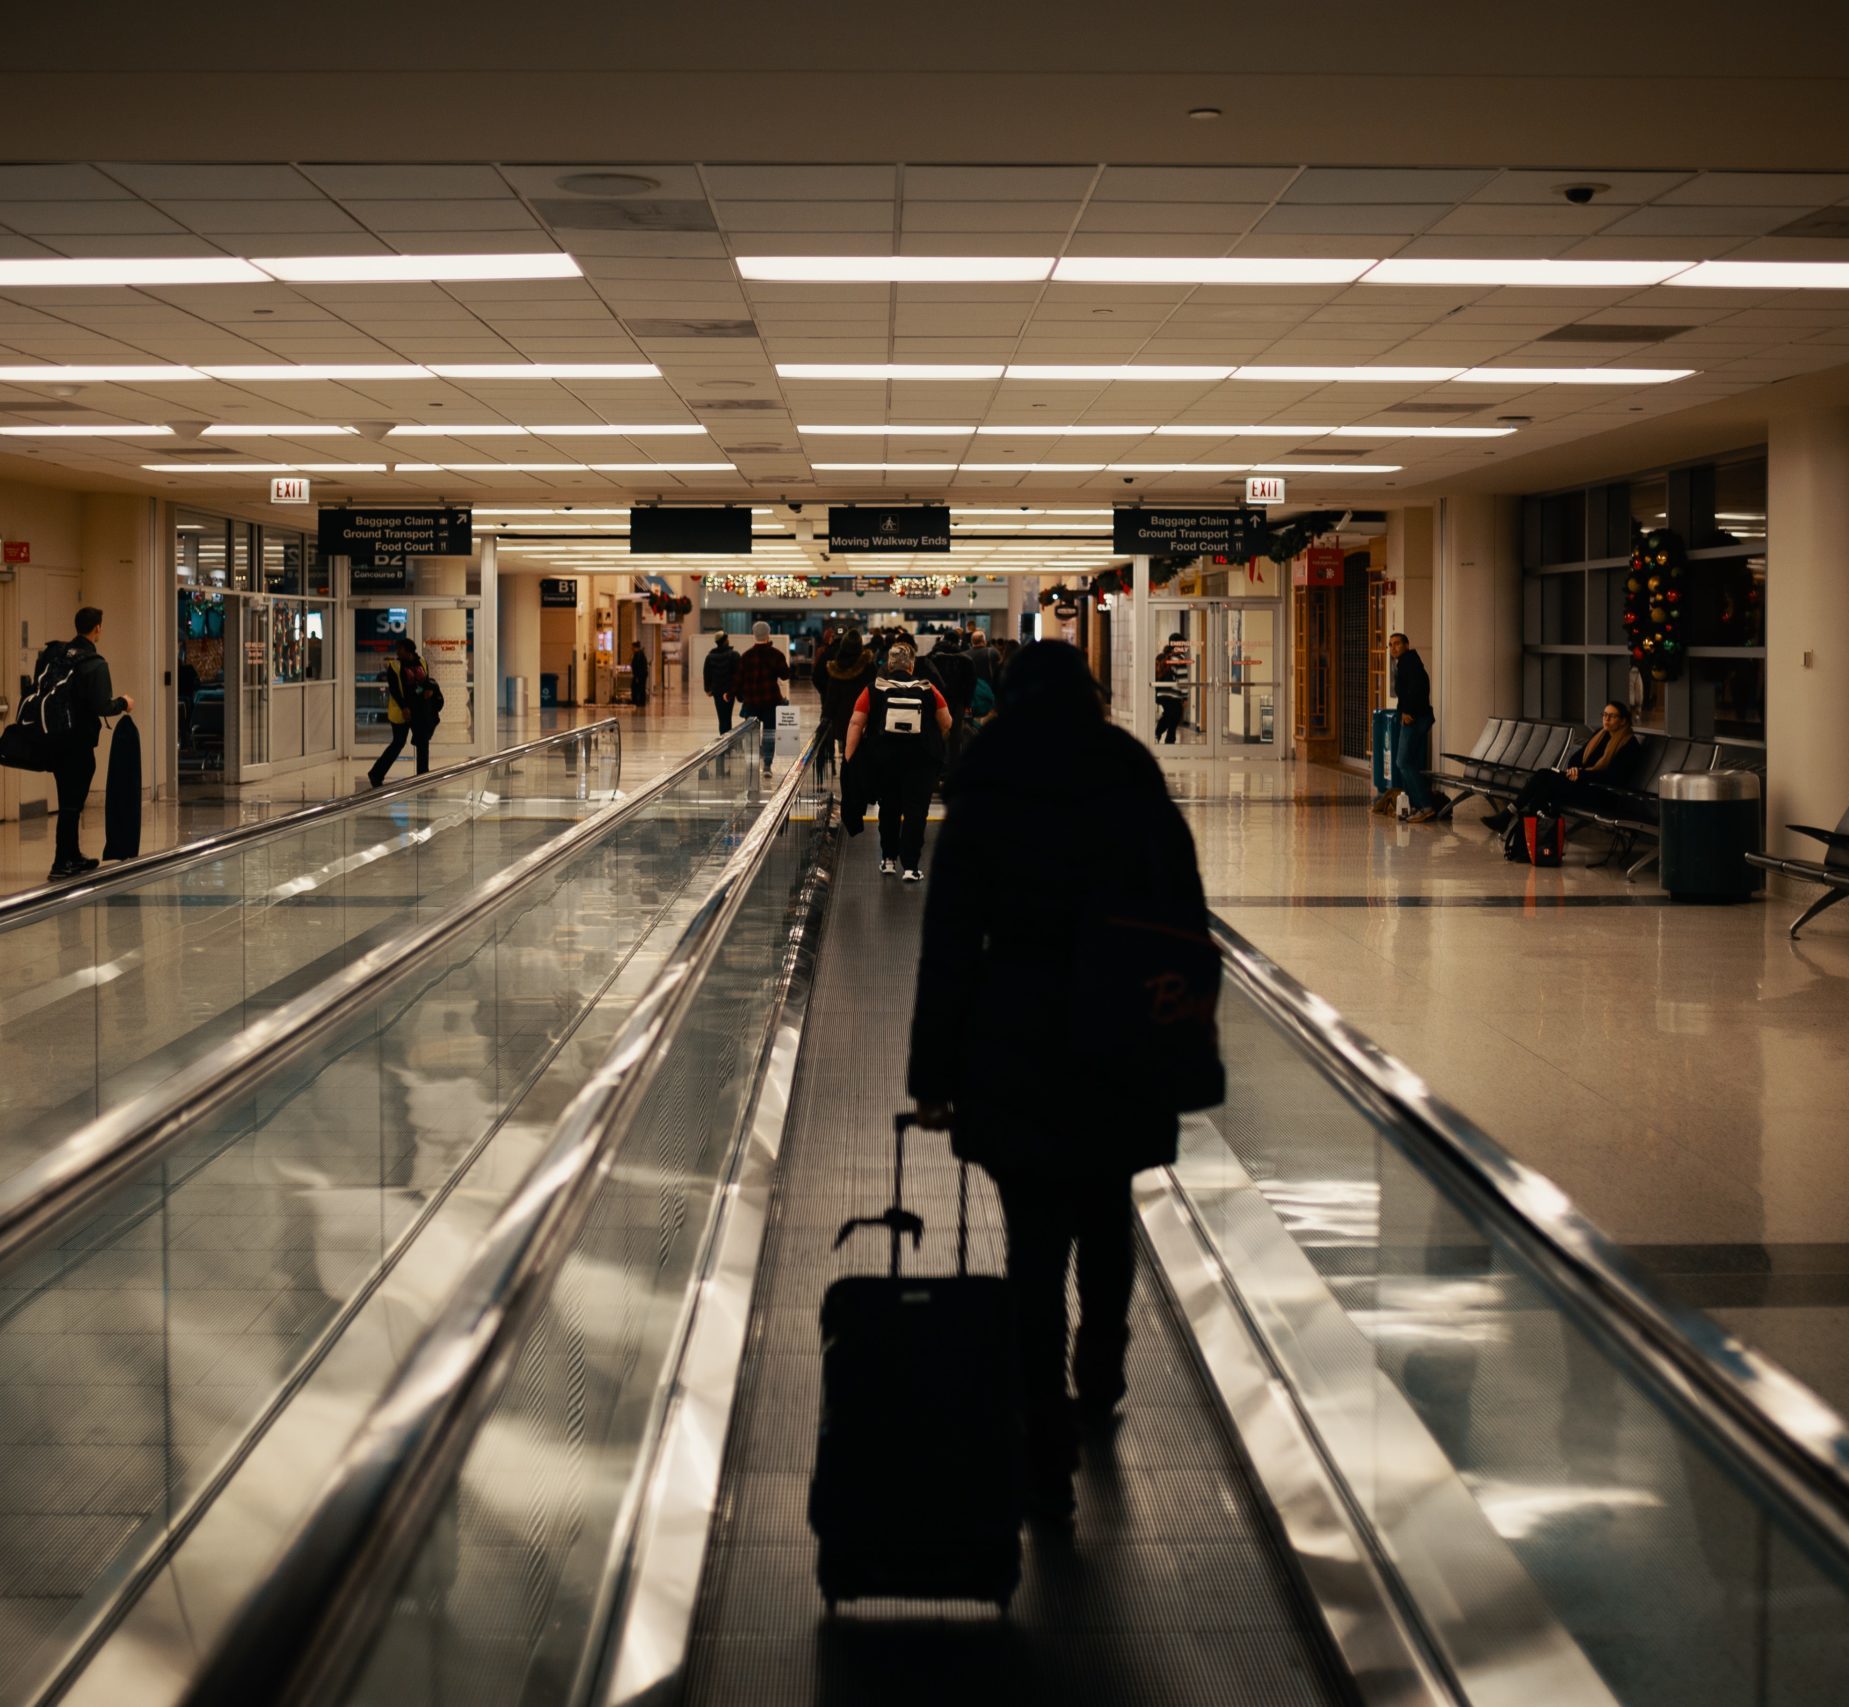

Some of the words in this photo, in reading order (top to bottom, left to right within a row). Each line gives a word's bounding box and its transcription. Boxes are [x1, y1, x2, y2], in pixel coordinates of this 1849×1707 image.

[276, 481, 303, 498] EXIT
[1252, 480, 1279, 497] EXIT
[355, 516, 401, 527] Baggage
[403, 516, 434, 526] Claim
[1150, 516, 1197, 527] Baggage
[1199, 516, 1229, 526] Claim
[343, 529, 382, 539] Ground
[384, 529, 434, 540] Transport
[1138, 529, 1177, 538] Ground
[1179, 529, 1229, 540] Transport
[375, 542, 401, 552] Food
[403, 542, 434, 552] Court
[831, 536, 869, 548] Moving
[872, 536, 919, 547] Walkway
[921, 536, 947, 546] Ends
[1170, 541, 1197, 552] Food
[1199, 541, 1229, 552] Court
[353, 570, 396, 579] Concourse
[558, 581, 576, 593] B1
